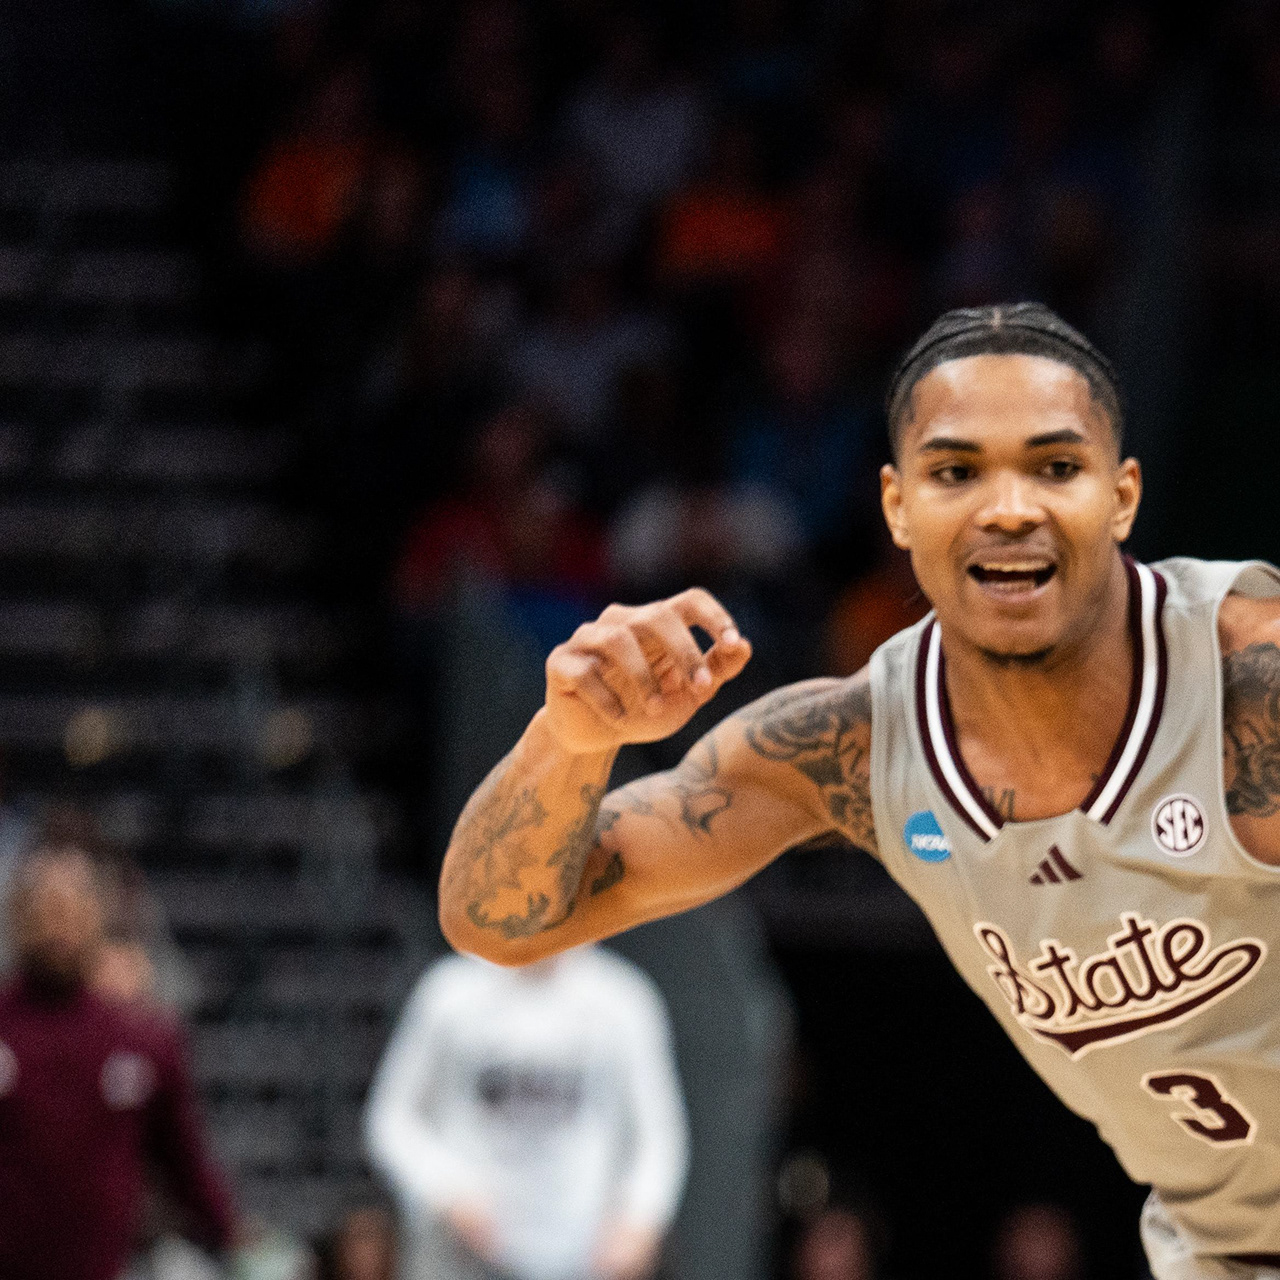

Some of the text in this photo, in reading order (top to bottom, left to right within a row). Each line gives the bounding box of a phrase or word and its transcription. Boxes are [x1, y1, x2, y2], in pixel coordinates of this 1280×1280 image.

[1157, 799, 1203, 850] SEC
[974, 912, 1267, 1060] State
[1142, 1068, 1255, 1147] 3
